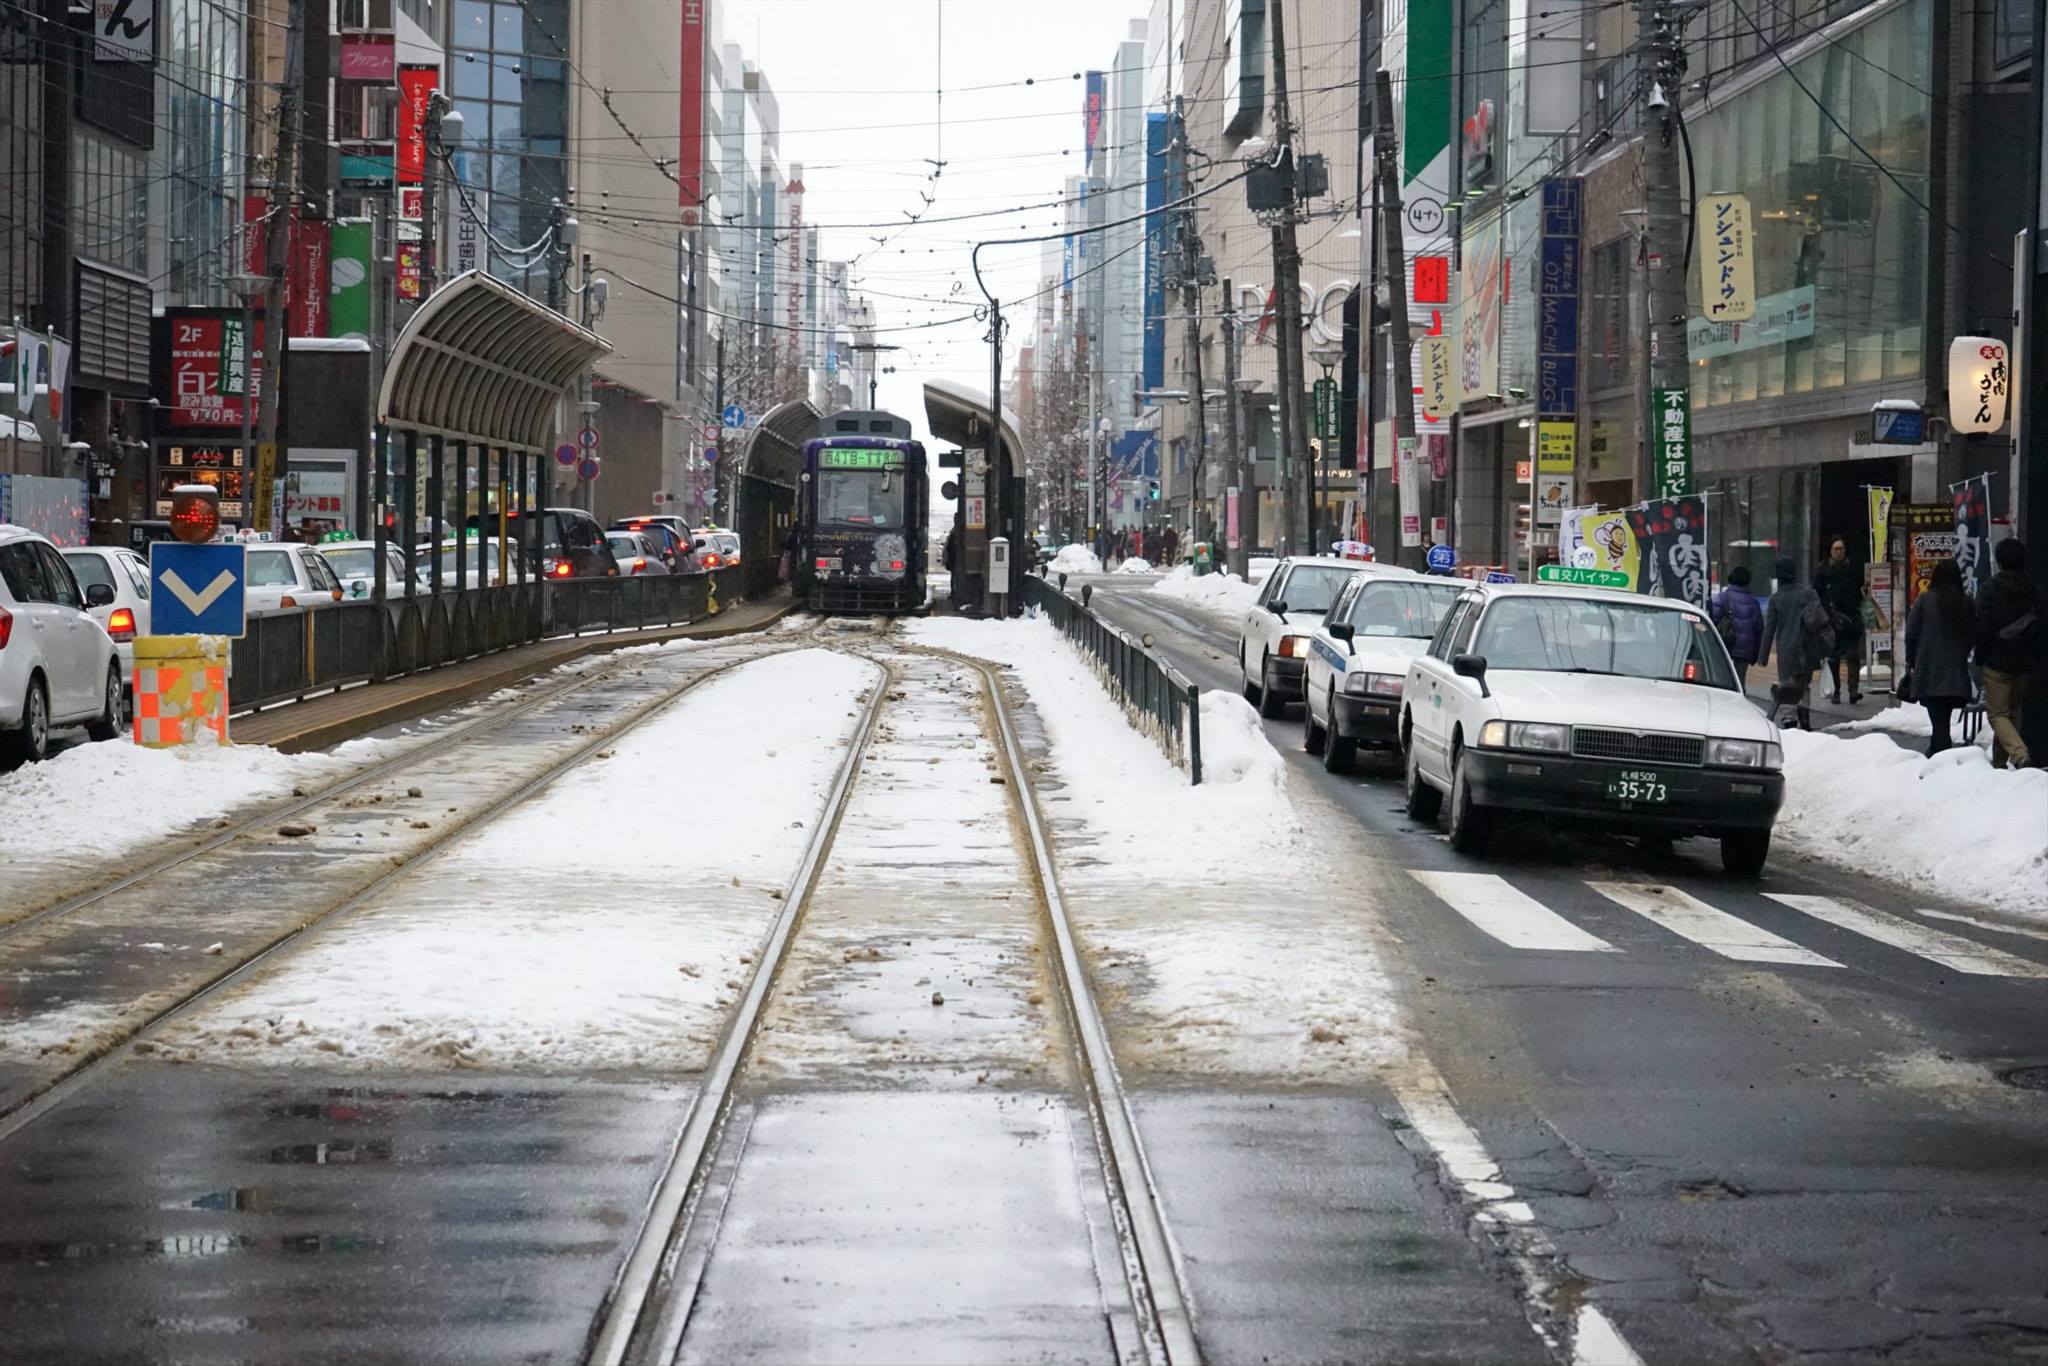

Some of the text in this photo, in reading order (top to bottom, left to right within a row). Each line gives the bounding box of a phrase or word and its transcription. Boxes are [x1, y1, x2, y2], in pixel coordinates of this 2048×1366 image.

[1148, 231, 1161, 297] CENTRAL
[1715, 202, 1736, 300] ソシュンドウ
[180, 325, 202, 343] 2F
[1974, 374, 1992, 424] うどん
[286, 496, 342, 512] ナント募集
[1618, 781, 1667, 801] 35-73
